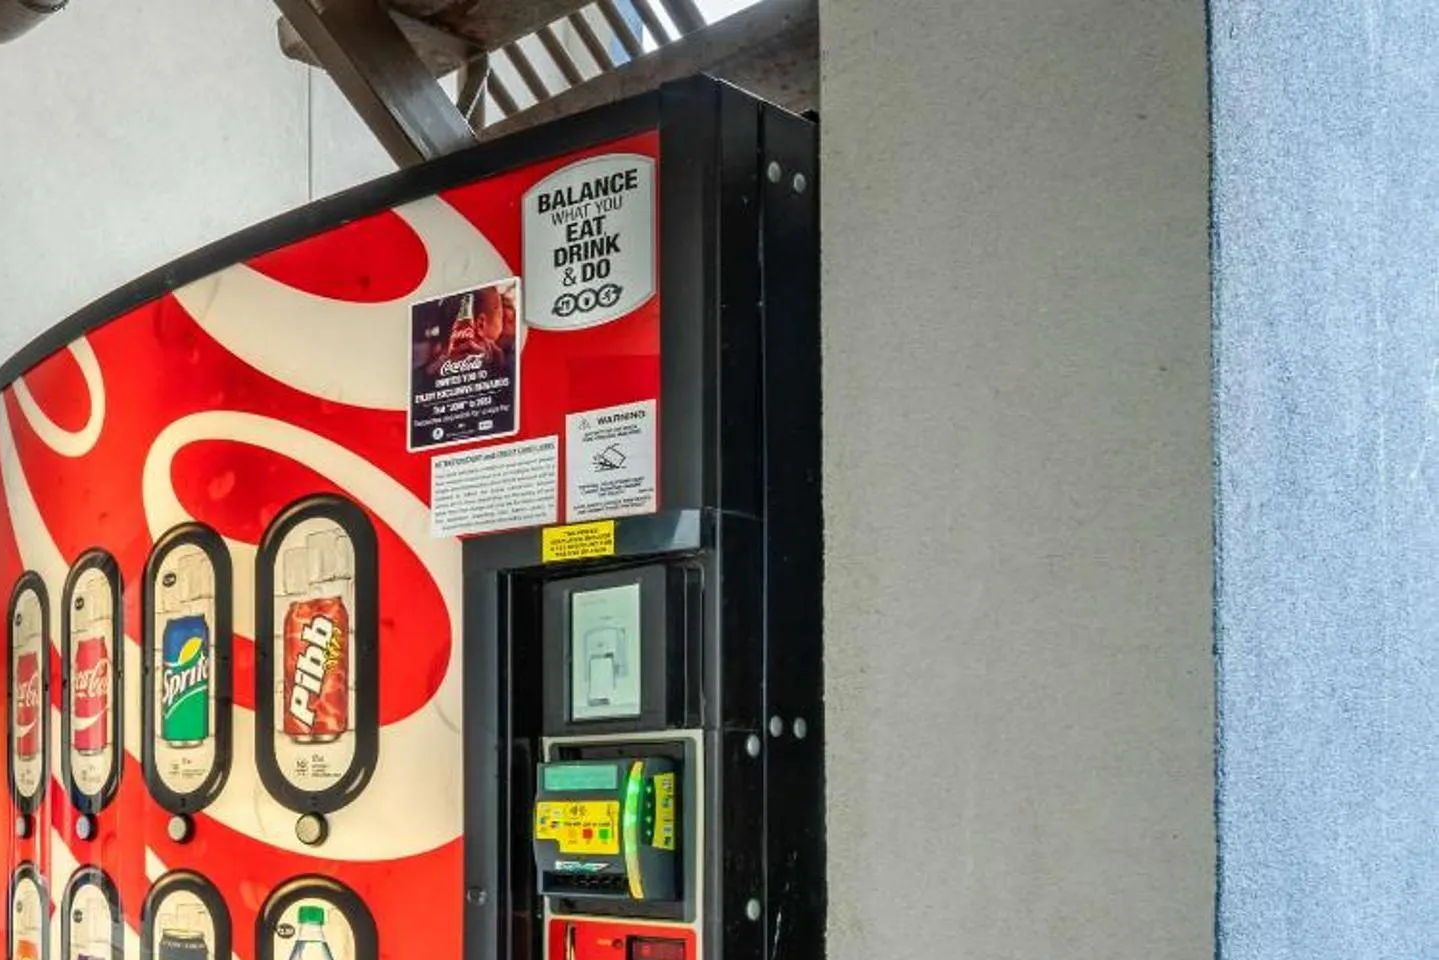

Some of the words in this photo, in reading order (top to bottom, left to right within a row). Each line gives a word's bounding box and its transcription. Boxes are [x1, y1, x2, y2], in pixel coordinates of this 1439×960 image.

[538, 168, 638, 214] BALANCE
[551, 203, 590, 226] WHAT
[594, 196, 622, 213] YOU
[554, 233, 620, 268] DRINK
[563, 267, 576, 287] &
[582, 258, 610, 282] DO
[162, 653, 209, 705] Sprite
[289, 616, 334, 728] Pibb
